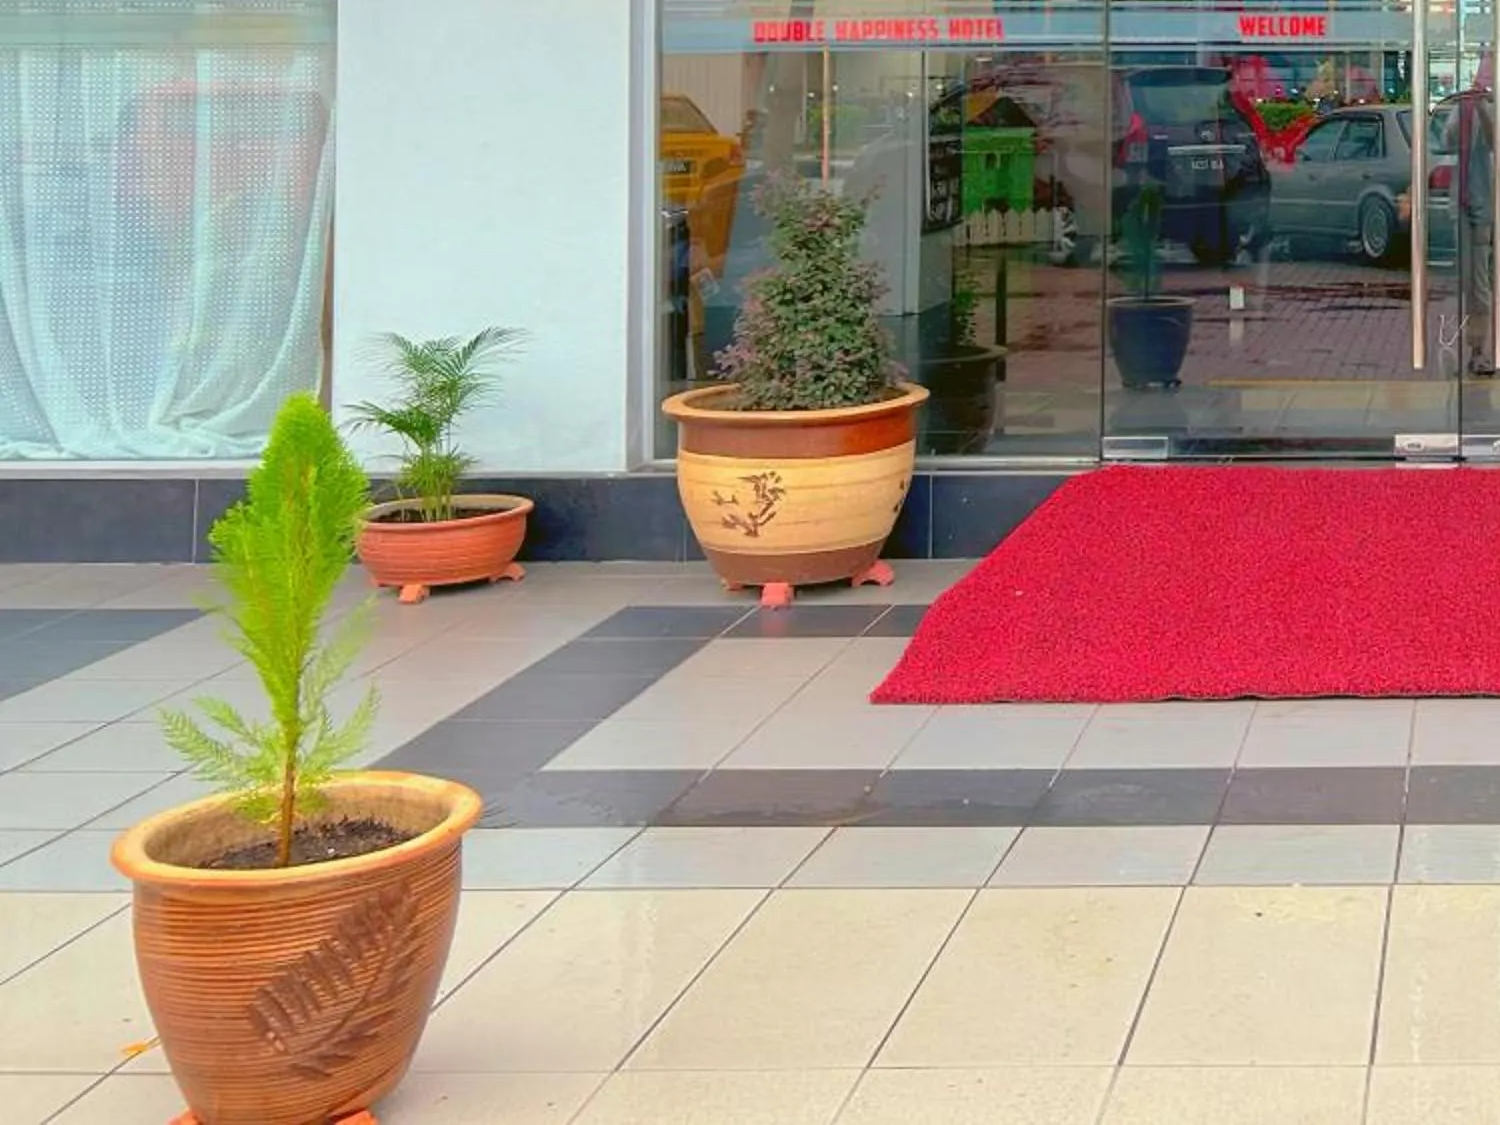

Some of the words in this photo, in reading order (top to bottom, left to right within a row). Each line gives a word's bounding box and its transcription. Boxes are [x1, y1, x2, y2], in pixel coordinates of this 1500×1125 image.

[754, 20, 825, 42] DOUBLE
[834, 18, 939, 41] HAPPINESS
[947, 18, 1004, 40] HOTEL
[1239, 16, 1326, 36] WELCOME
